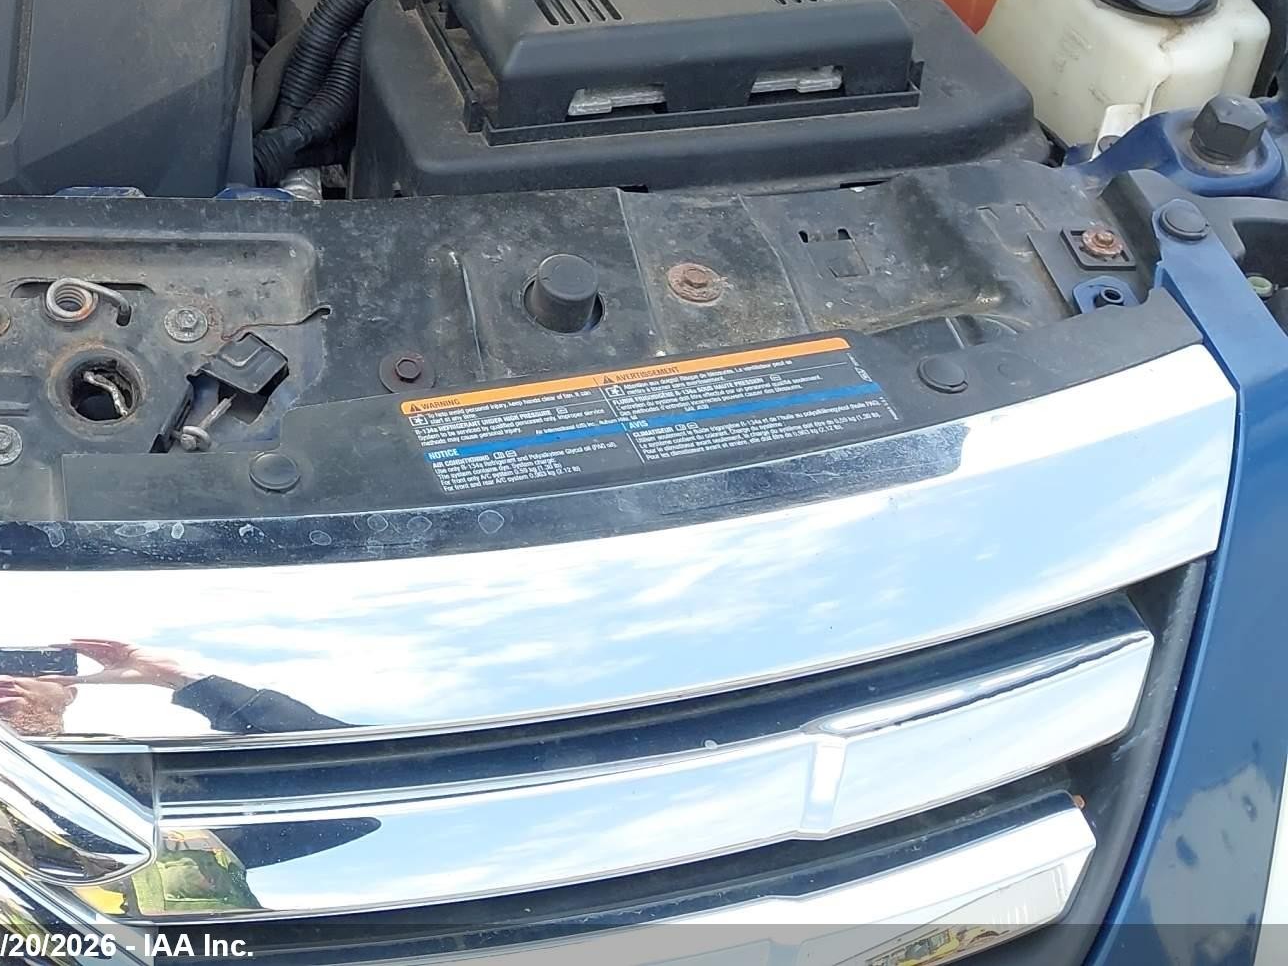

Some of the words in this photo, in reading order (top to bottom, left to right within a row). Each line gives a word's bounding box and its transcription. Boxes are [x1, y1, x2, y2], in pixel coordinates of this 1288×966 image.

[617, 367, 678, 380] AVERTISSEMENT
[421, 399, 460, 409] WARNING
[629, 420, 648, 428] AVIS
[429, 449, 458, 459] NOTICE
